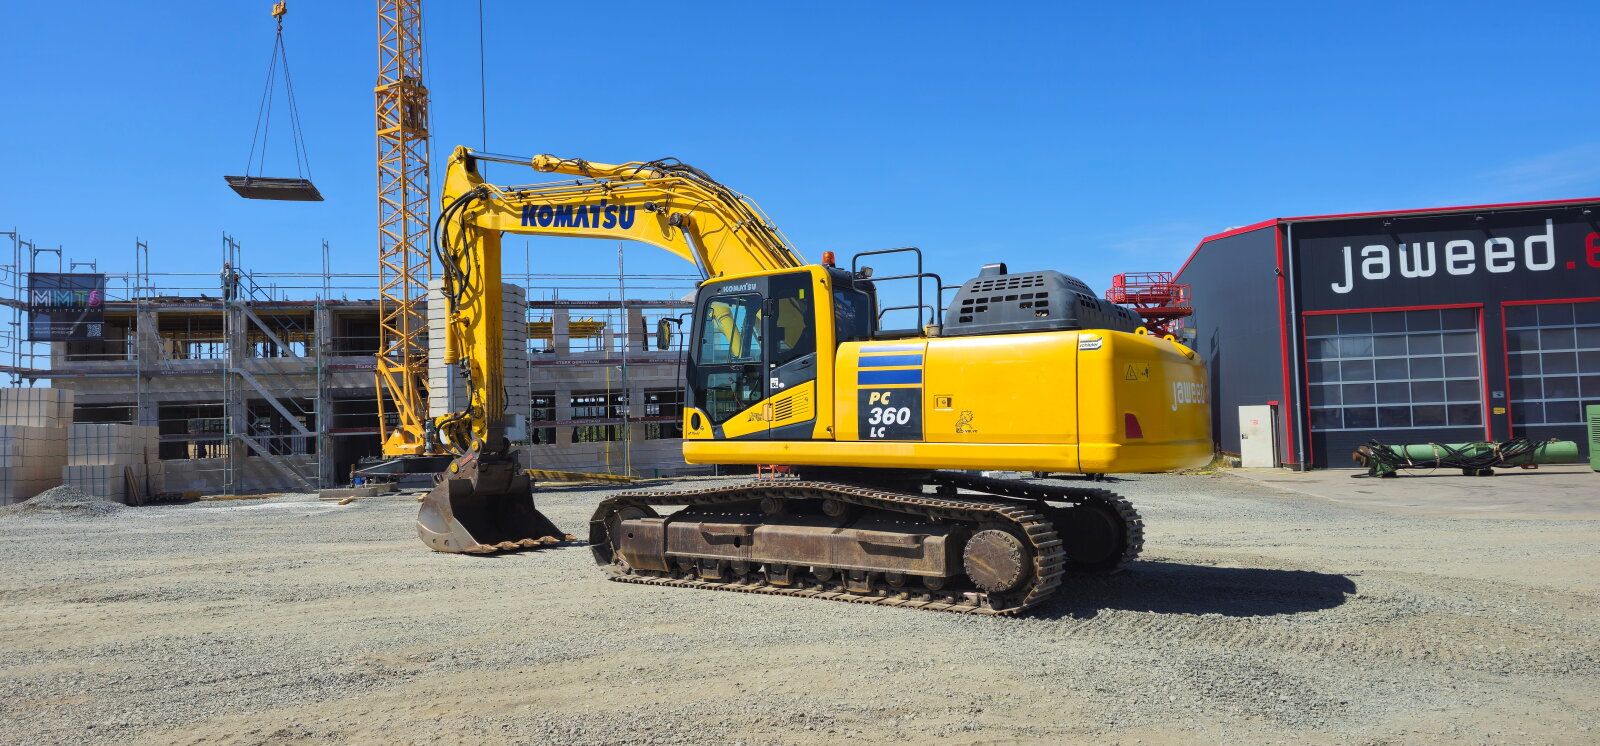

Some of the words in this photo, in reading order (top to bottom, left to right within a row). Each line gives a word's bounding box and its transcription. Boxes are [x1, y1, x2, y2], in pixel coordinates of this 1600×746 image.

[521, 199, 636, 230] KOMATSU
[723, 283, 757, 293] KOMATSU
[31, 289, 102, 308] MMTS
[868, 391, 891, 405] PC
[868, 407, 911, 425] 360
[869, 427, 886, 438] LC
